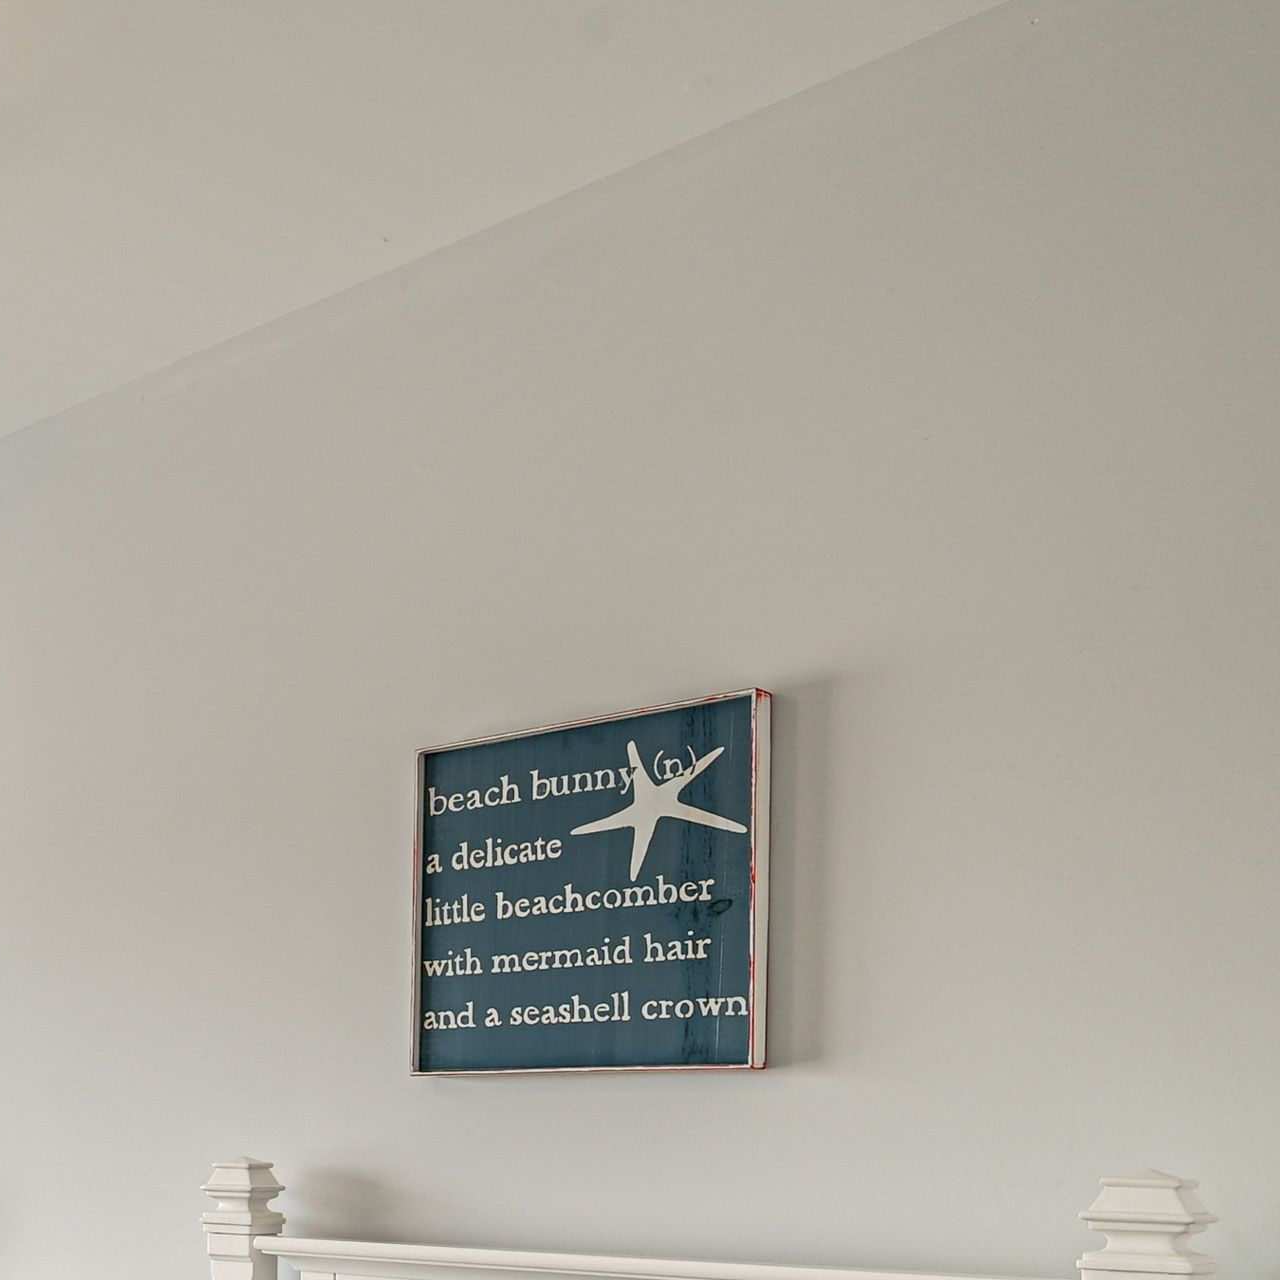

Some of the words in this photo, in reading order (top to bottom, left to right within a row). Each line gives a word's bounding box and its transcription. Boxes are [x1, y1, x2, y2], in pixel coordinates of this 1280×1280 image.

[428, 775, 522, 817] beach
[529, 766, 638, 801] bunny
[653, 745, 697, 780] (n)
[426, 852, 442, 875] a
[451, 836, 563, 870] delicate
[424, 894, 487, 927] little
[495, 875, 716, 920] beachcomber
[423, 948, 483, 977] with
[491, 937, 632, 974] mermaid
[643, 930, 712, 962] hair
[423, 1002, 477, 1031] and
[485, 1009, 502, 1028] a
[509, 991, 631, 1026] seashell
[641, 994, 749, 1019] crown
